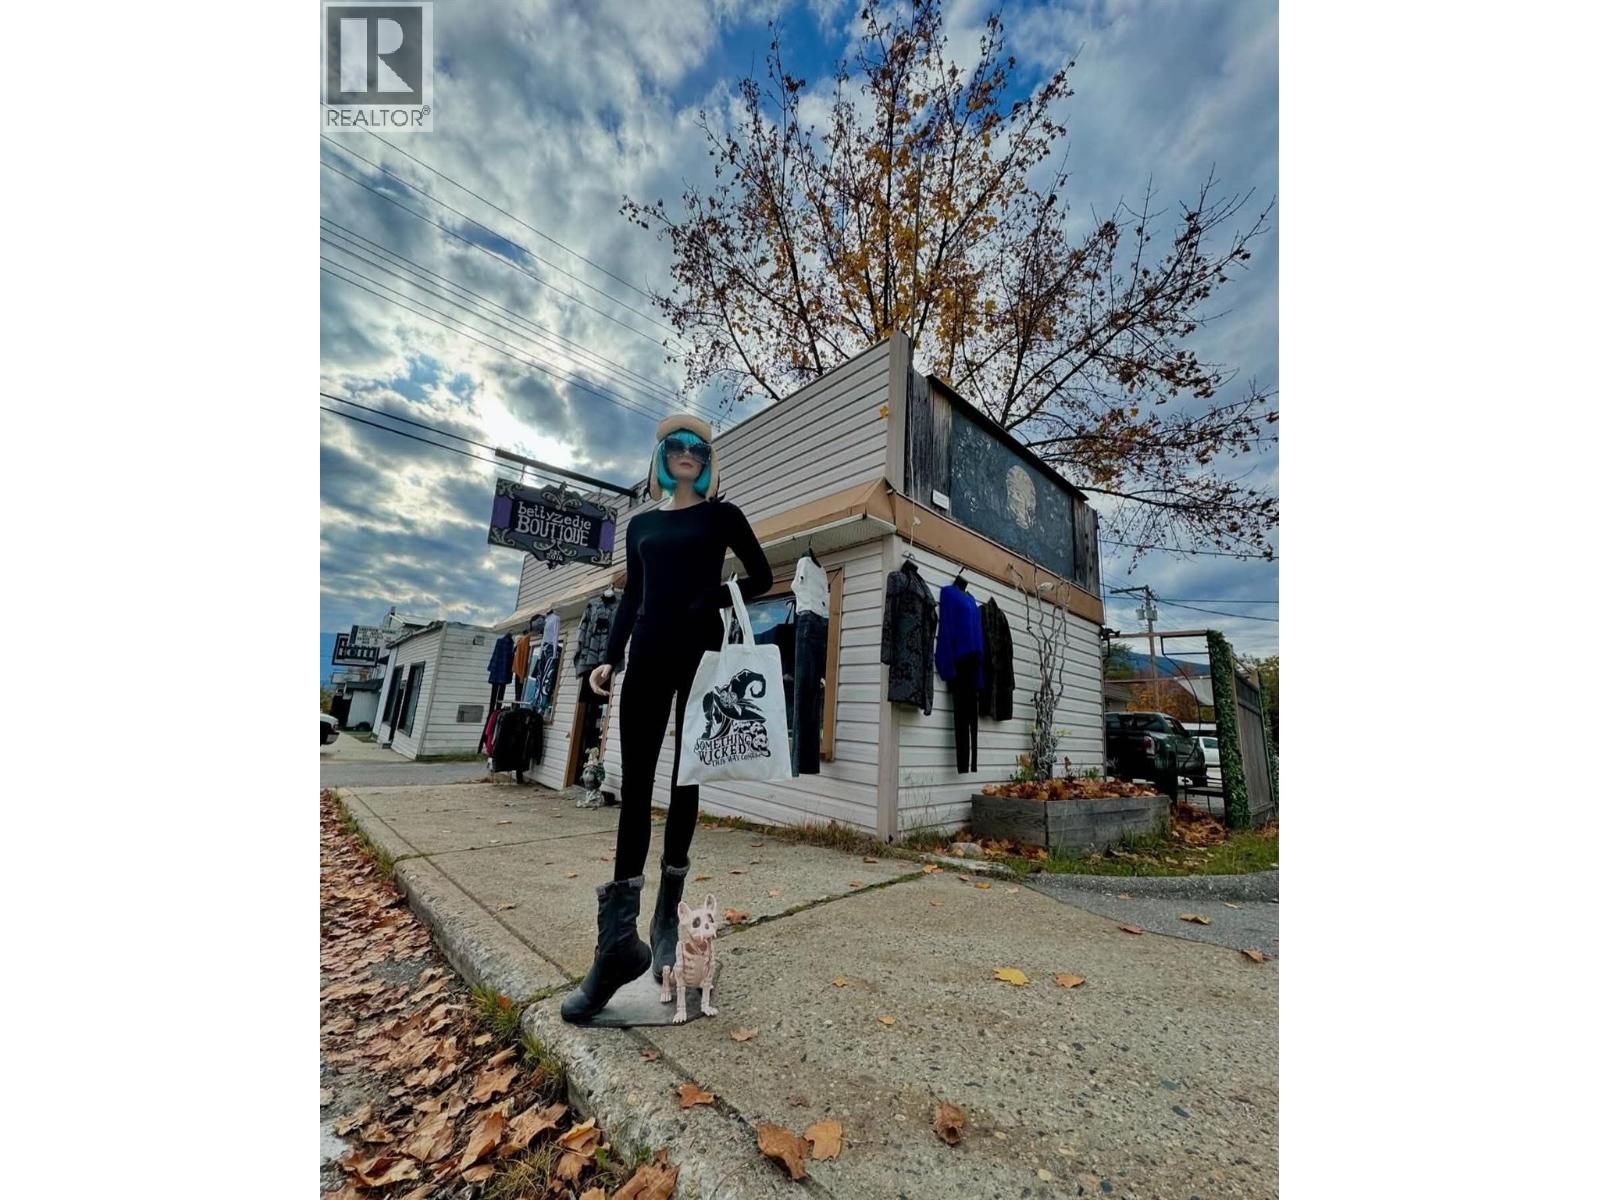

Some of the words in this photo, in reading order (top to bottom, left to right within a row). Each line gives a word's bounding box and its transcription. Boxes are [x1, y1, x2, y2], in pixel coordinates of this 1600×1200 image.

[515, 514, 589, 547] BOUTIQUE
[694, 733, 753, 753] SOMETHING
[698, 743, 747, 766] WICKED
